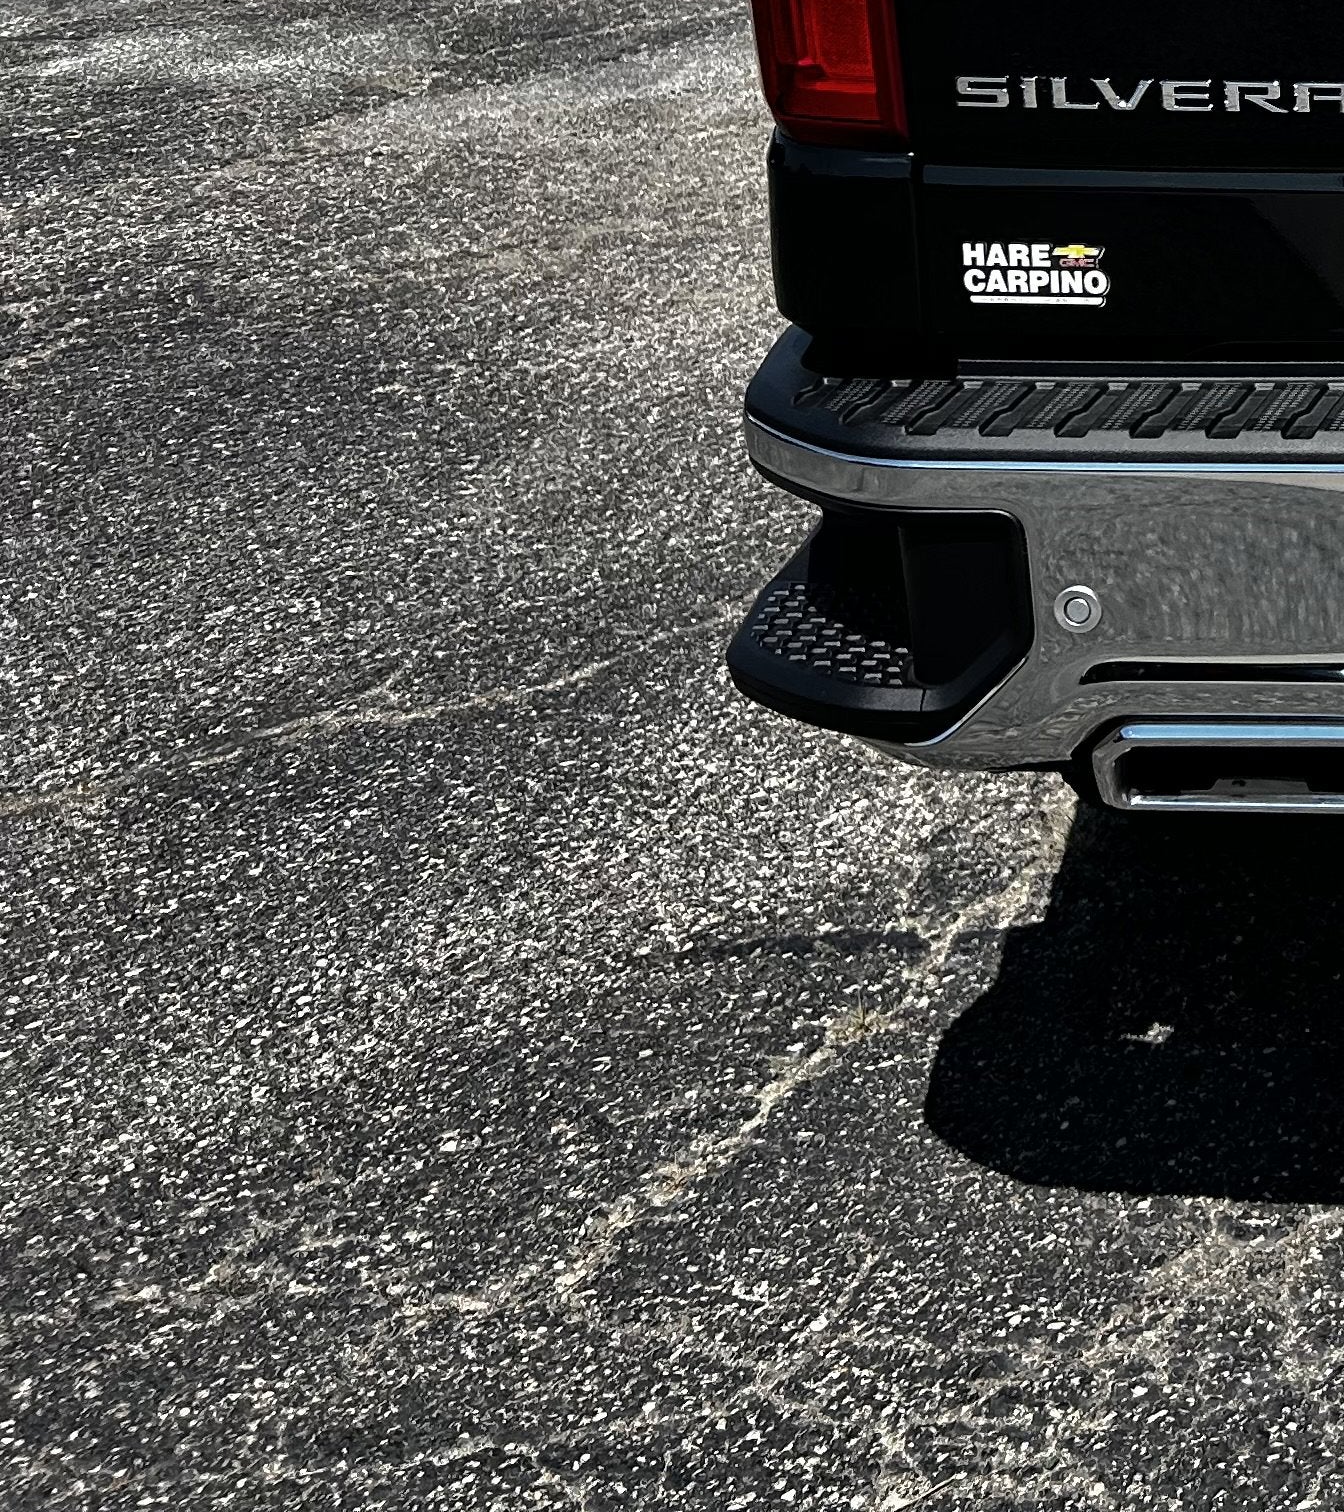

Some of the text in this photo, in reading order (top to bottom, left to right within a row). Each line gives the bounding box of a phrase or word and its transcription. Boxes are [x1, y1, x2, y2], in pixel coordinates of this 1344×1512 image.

[961, 242, 1052, 268] HARE
[1059, 258, 1095, 268] GMC
[963, 268, 1108, 295] CARPINO
